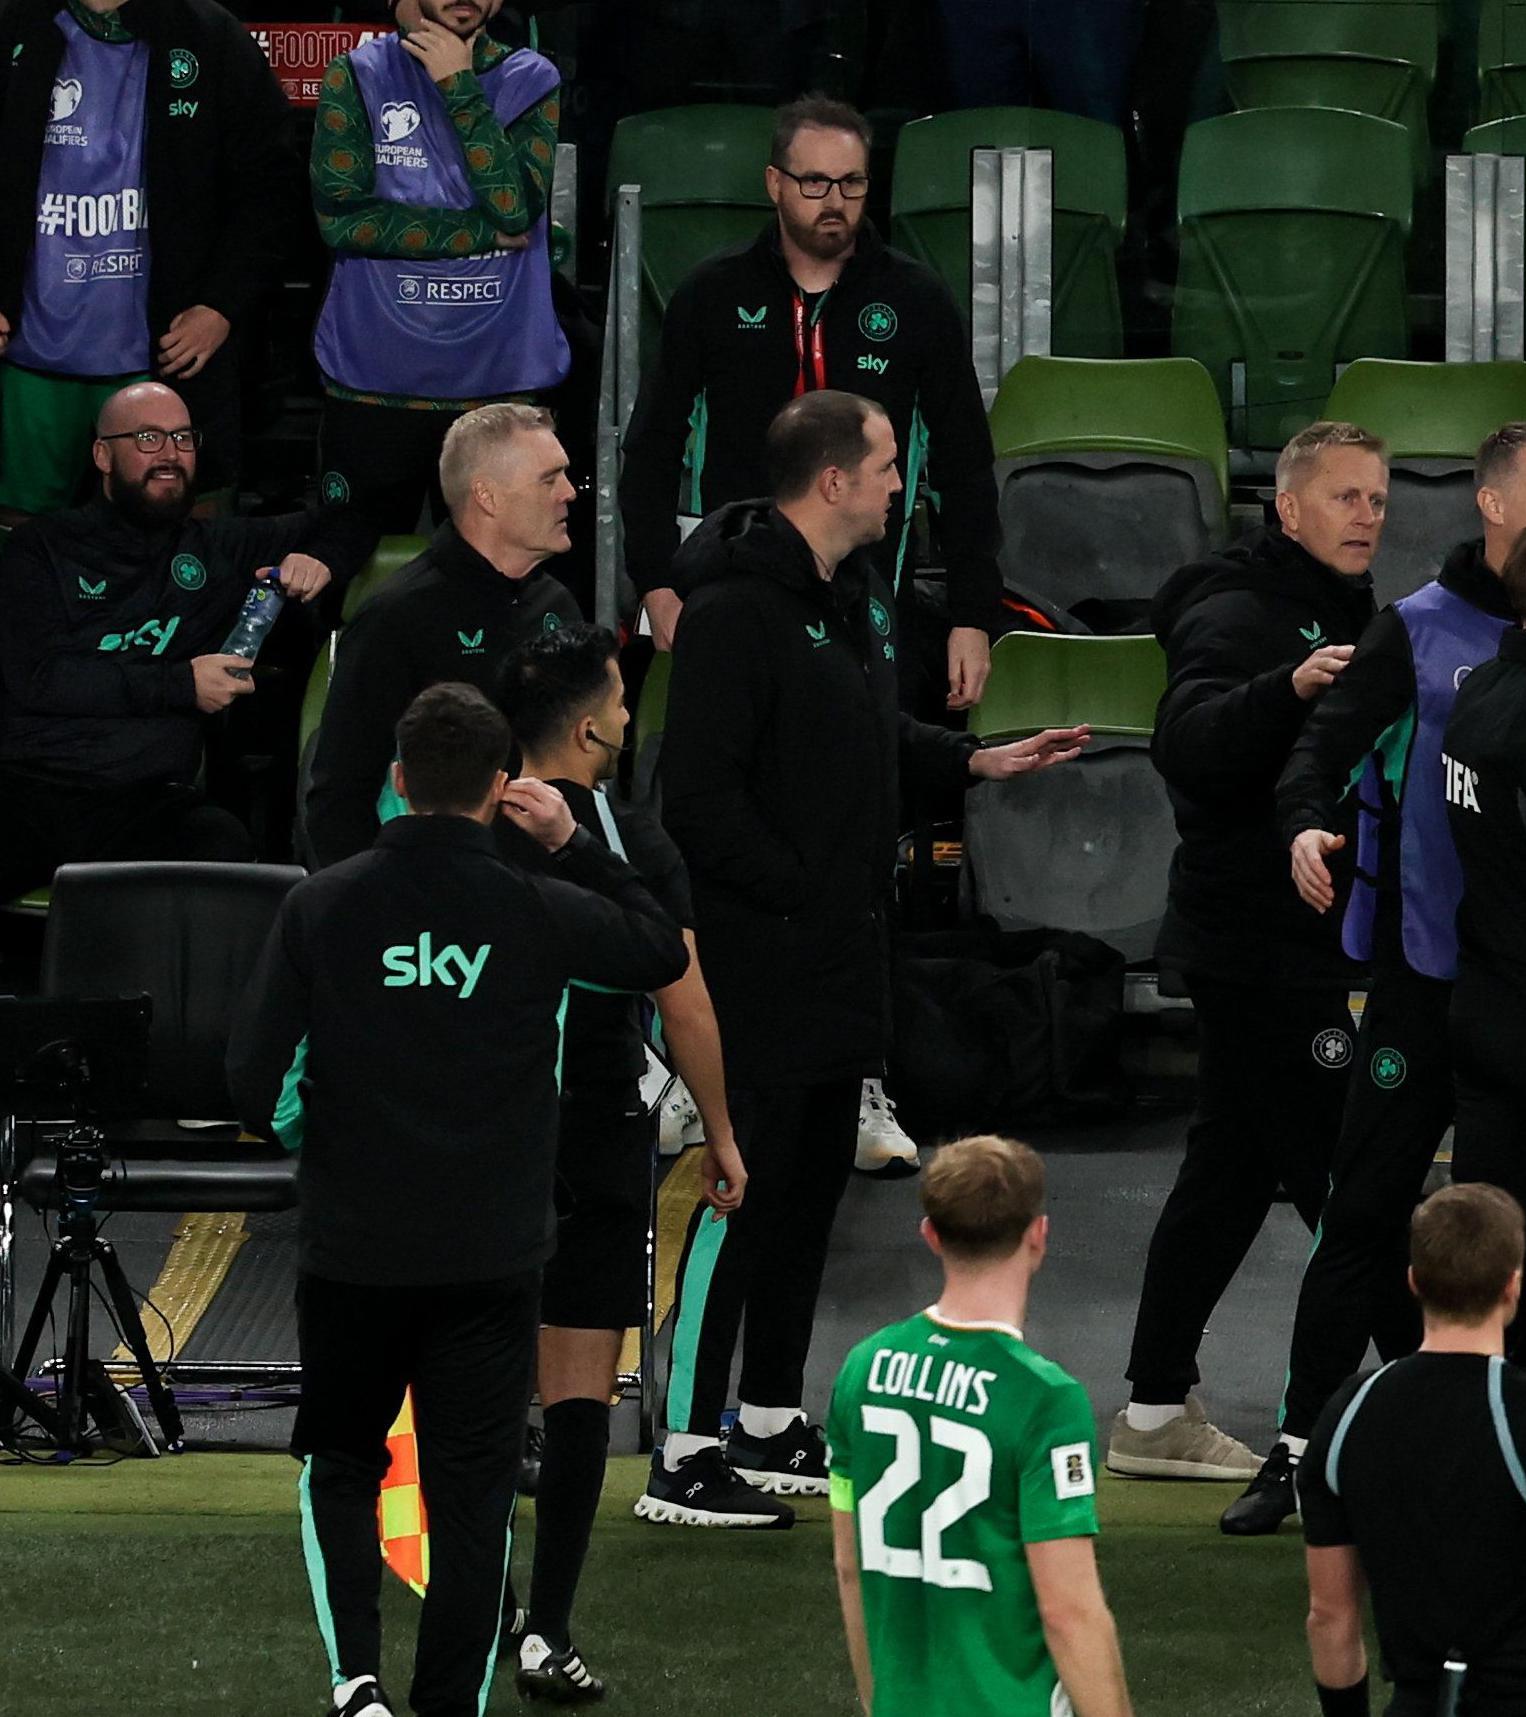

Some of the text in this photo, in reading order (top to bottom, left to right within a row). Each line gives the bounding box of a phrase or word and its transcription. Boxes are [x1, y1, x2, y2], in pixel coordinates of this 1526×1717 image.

[168, 98, 199, 118] sky
[427, 281, 502, 300] RESPECT
[857, 353, 889, 375] sky
[382, 931, 492, 999] sky
[866, 1348, 998, 1416] COLLINS
[857, 1404, 994, 1593] 22
